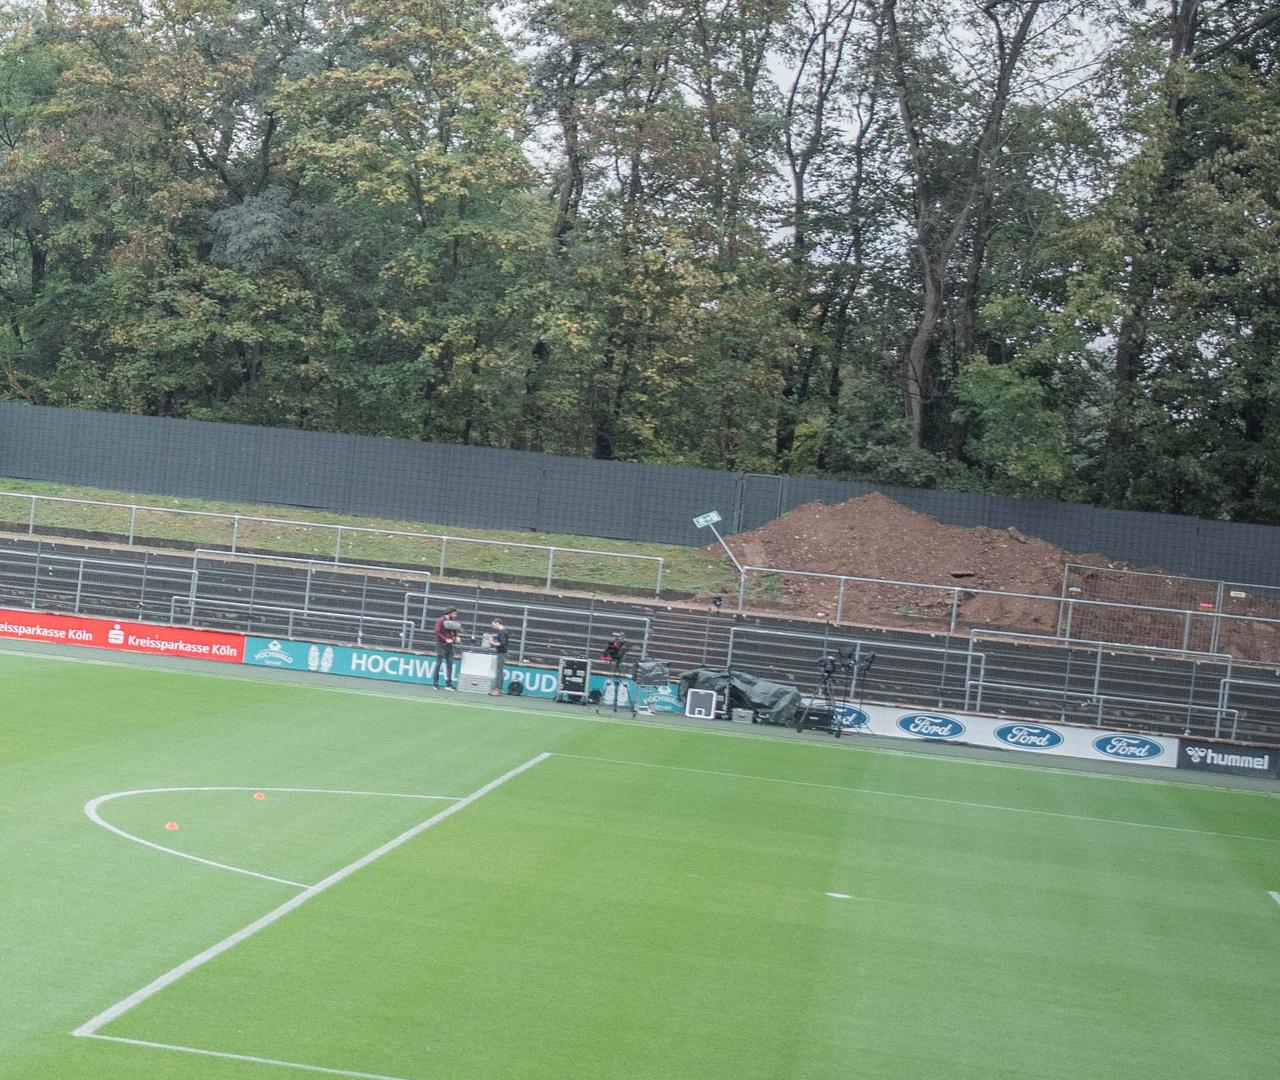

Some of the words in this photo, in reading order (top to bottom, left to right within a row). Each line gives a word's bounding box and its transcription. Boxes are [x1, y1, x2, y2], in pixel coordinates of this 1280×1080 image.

[69, 627, 93, 642] Köln
[128, 634, 209, 655] Kreissparkasse
[212, 643, 237, 658] Köln
[351, 652, 458, 682] HOCHWAL
[909, 716, 953, 736] Ford
[1007, 726, 1051, 746] Ford
[1106, 737, 1150, 757] Ford
[1206, 749, 1269, 770] hummel
